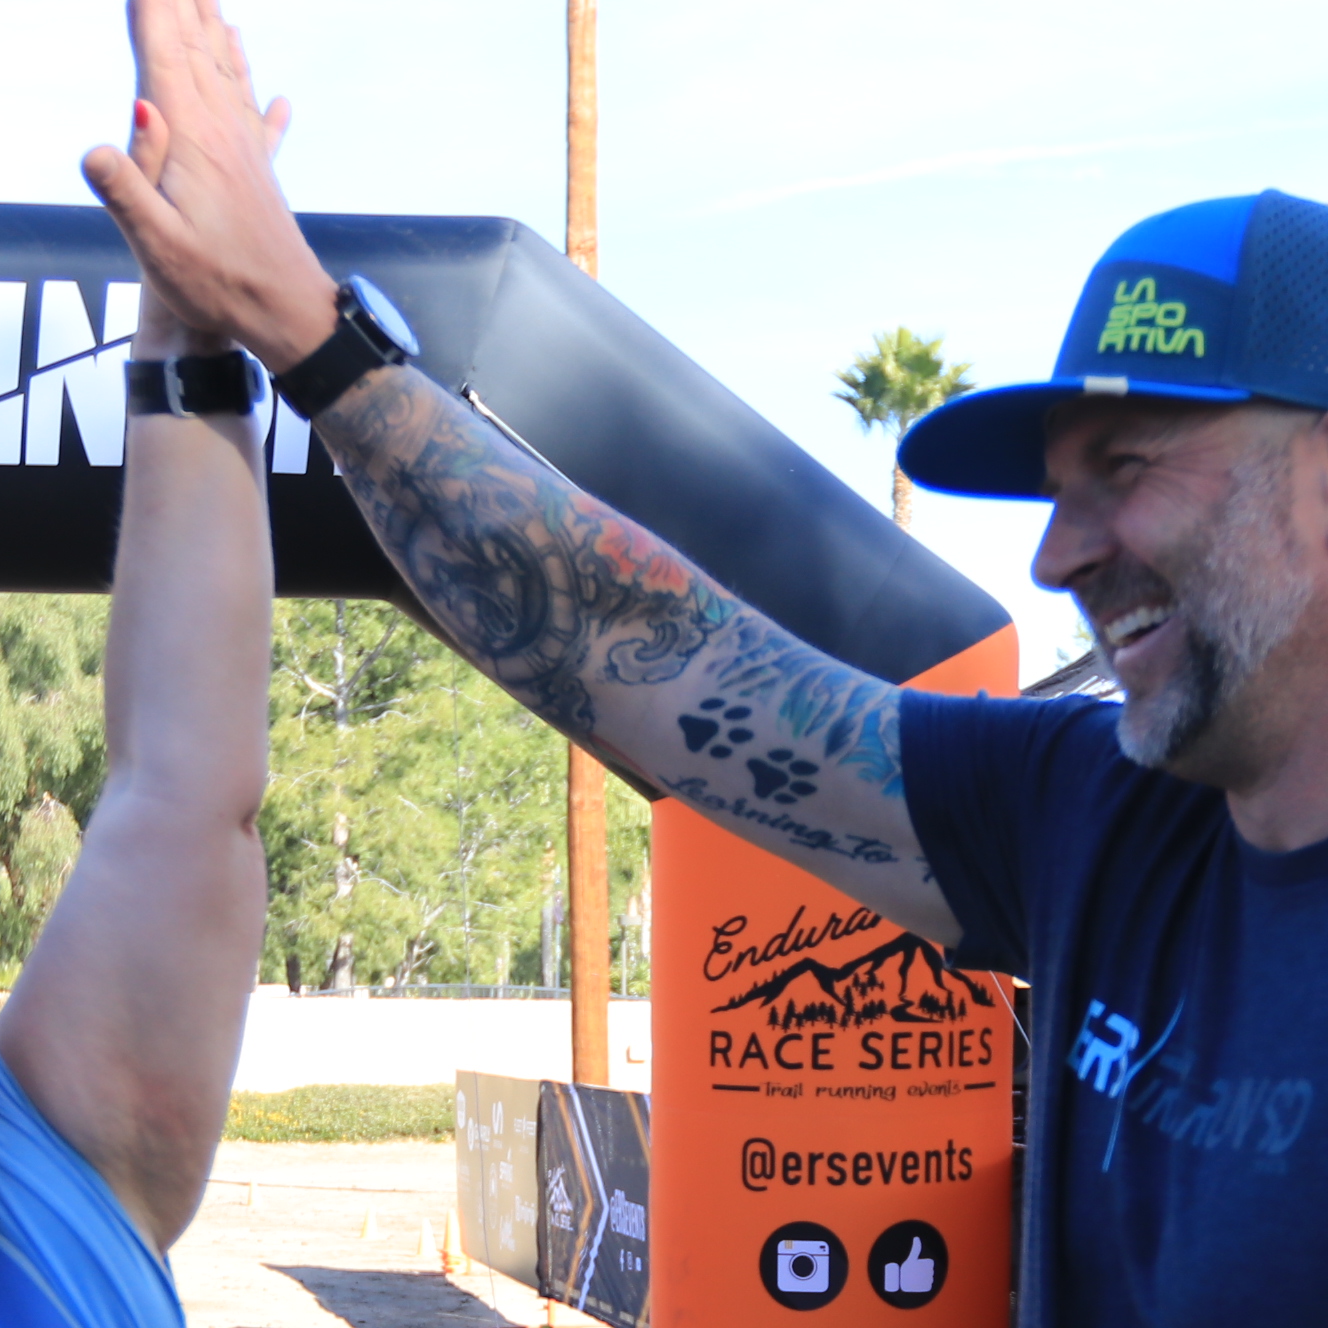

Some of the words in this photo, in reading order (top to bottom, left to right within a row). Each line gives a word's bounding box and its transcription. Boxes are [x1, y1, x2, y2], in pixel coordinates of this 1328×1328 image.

[1114, 277, 1156, 304] LA
[1105, 302, 1187, 328] SPO
[702, 905, 884, 982] Endura
[710, 1030, 836, 1071] RACE
[858, 1027, 993, 1071] SERIES
[815, 1083, 897, 1101] running
[741, 1137, 973, 1192] @ersevents
